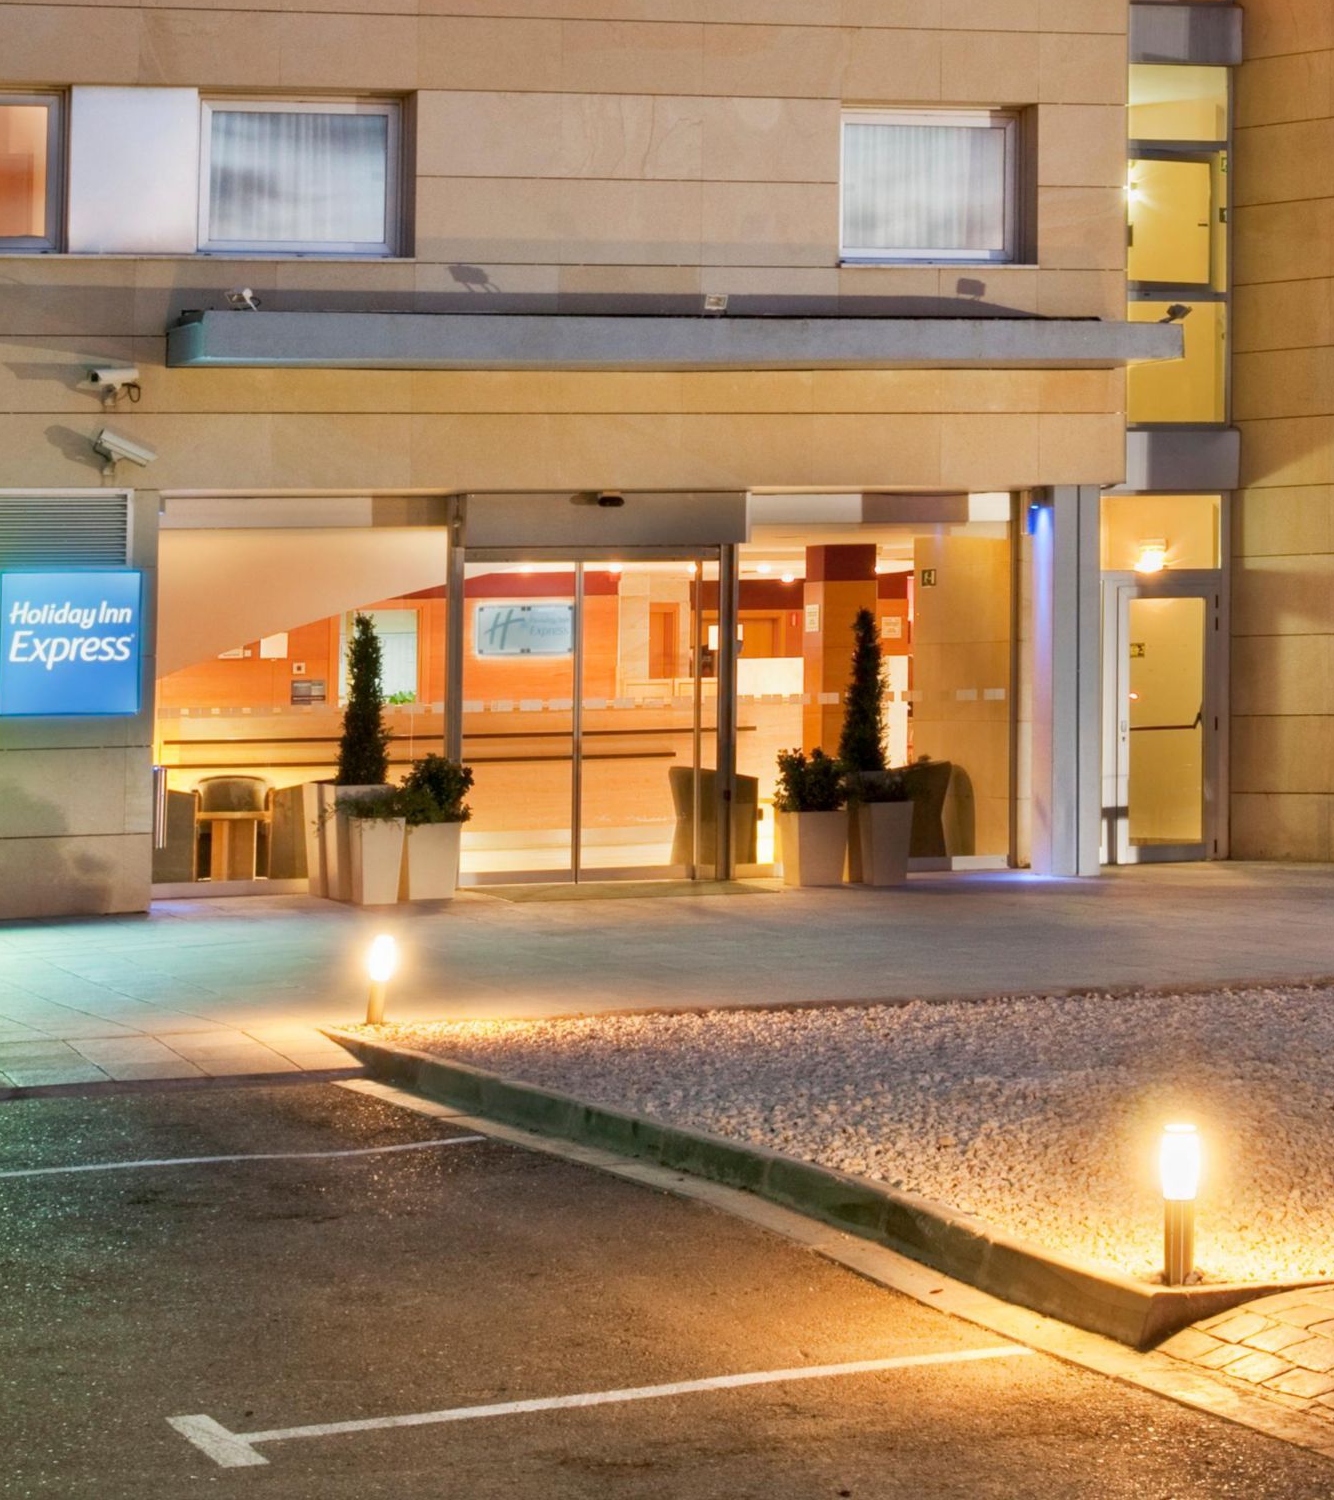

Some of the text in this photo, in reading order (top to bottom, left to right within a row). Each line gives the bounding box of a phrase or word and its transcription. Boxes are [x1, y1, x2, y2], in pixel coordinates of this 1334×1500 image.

[9, 601, 132, 629] Holiday Inn
[9, 630, 132, 670] Express
